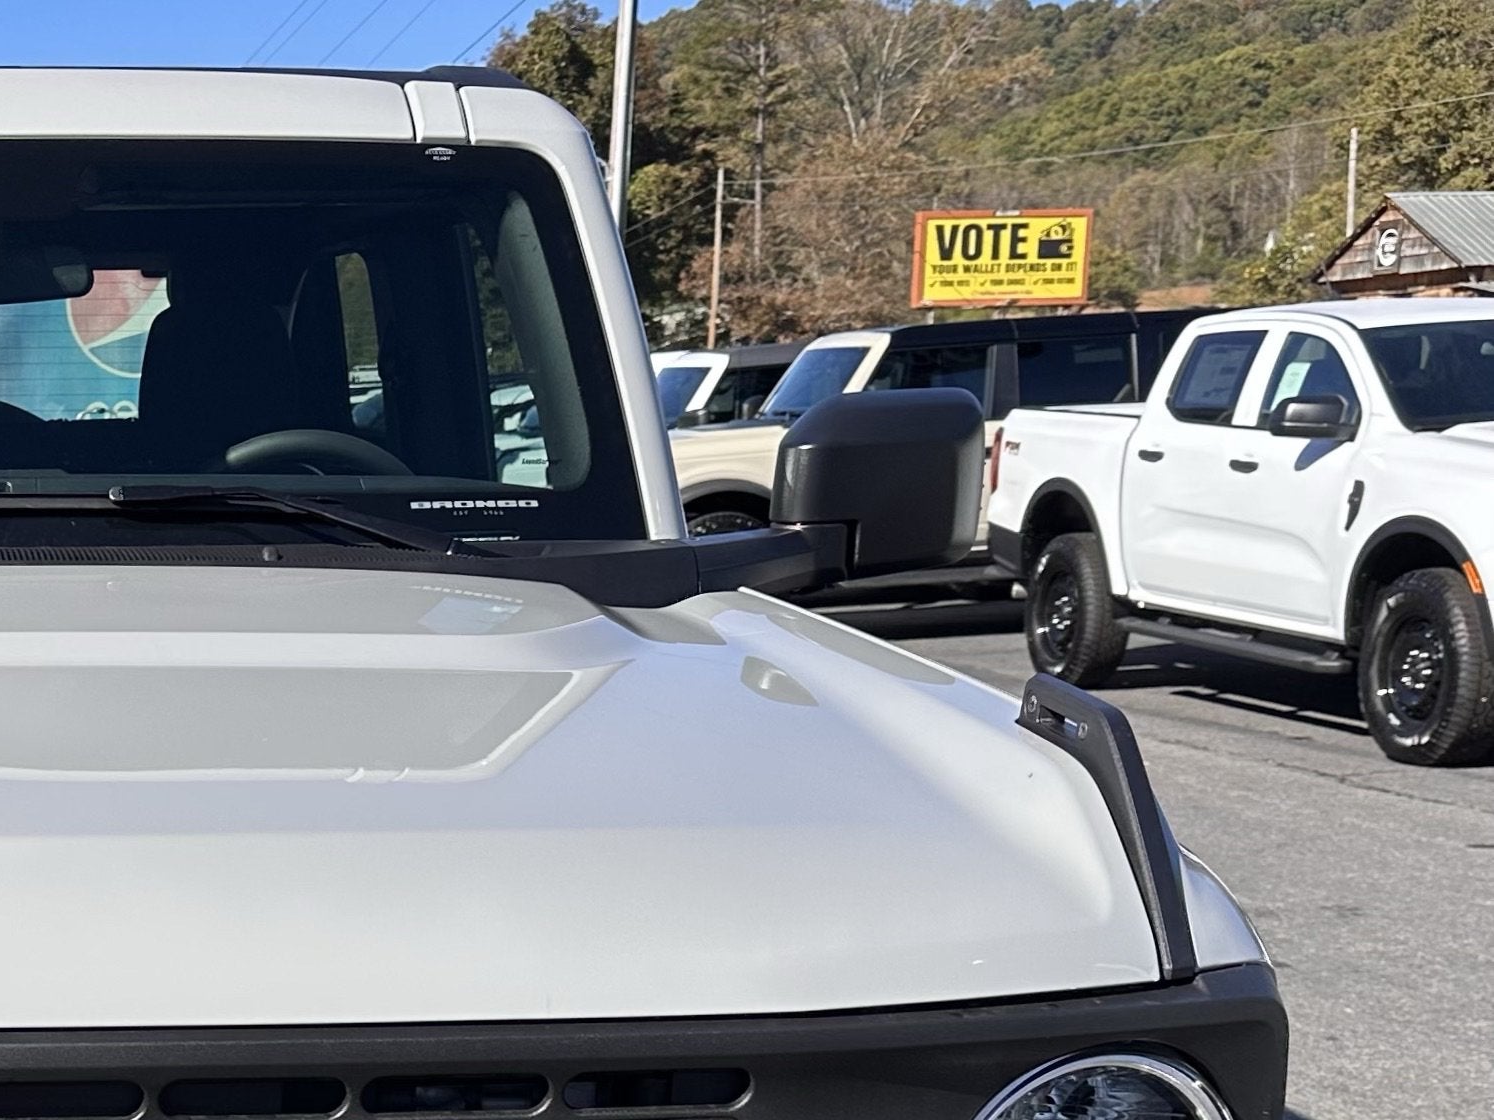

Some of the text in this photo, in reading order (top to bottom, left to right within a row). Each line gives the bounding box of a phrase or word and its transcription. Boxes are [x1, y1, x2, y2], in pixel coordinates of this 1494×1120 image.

[935, 222, 1030, 262] VOTE
[931, 263, 959, 275] YOUR
[963, 263, 1002, 273] WALLET
[1005, 262, 1047, 273] DEPENDS
[1051, 262, 1063, 272] ON
[410, 500, 539, 509] BRONCO
